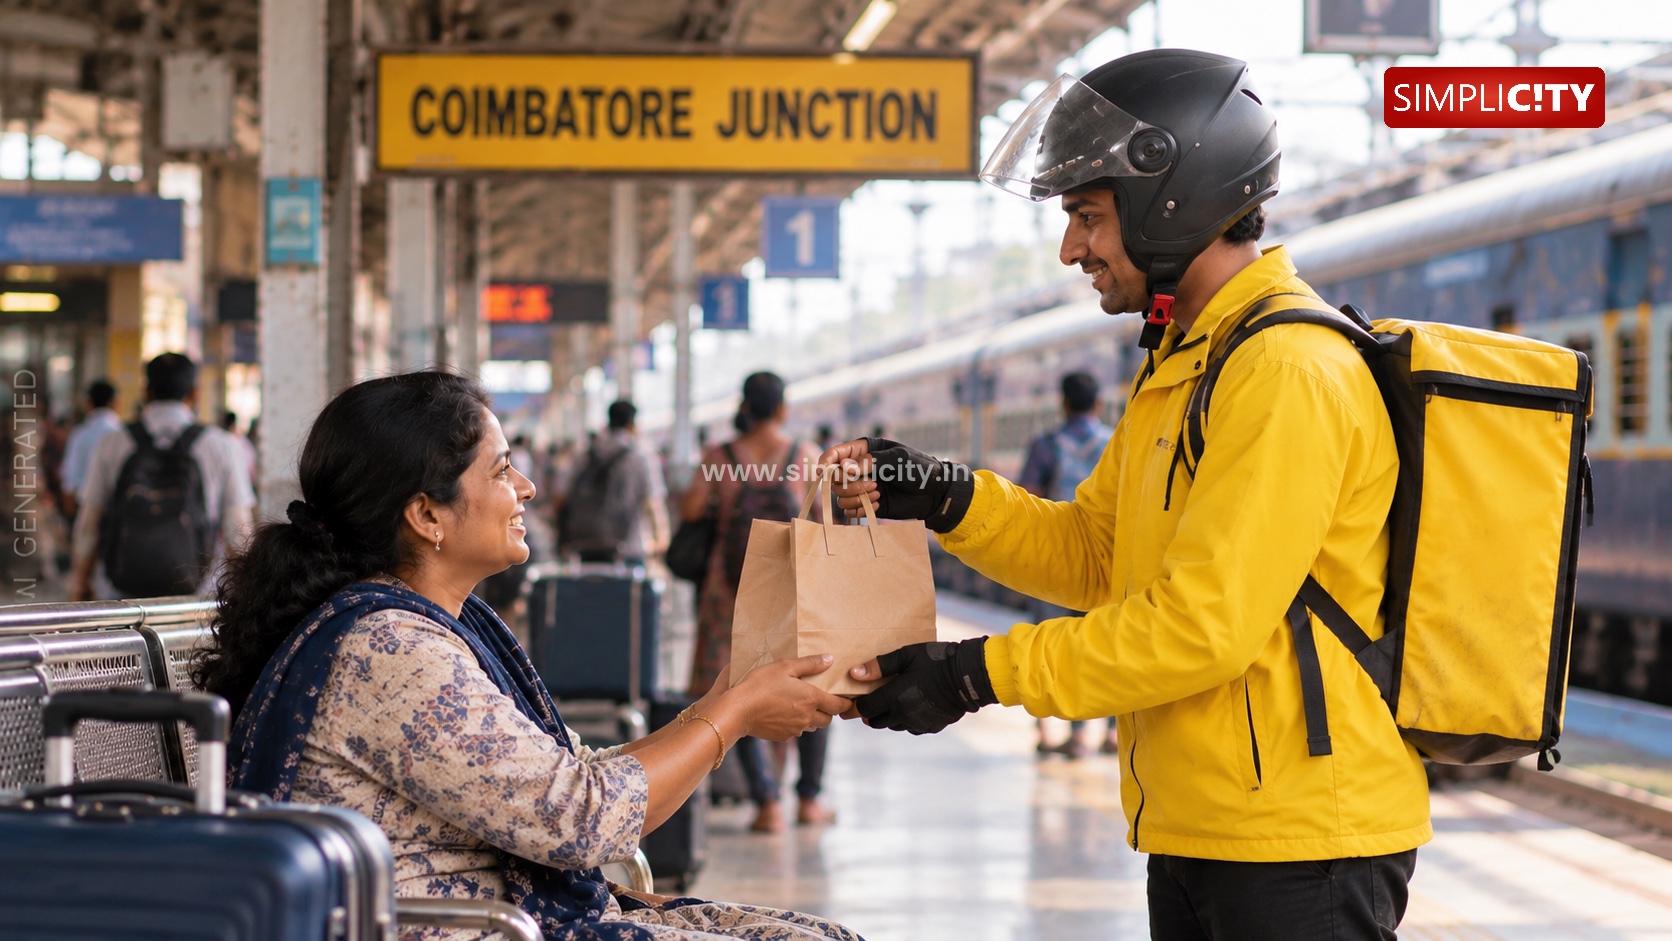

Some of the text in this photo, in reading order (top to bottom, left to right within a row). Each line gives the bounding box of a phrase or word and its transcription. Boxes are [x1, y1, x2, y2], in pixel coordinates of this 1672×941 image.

[410, 85, 938, 141] COIMBATORE JUNCTION
[785, 210, 814, 266] 1
